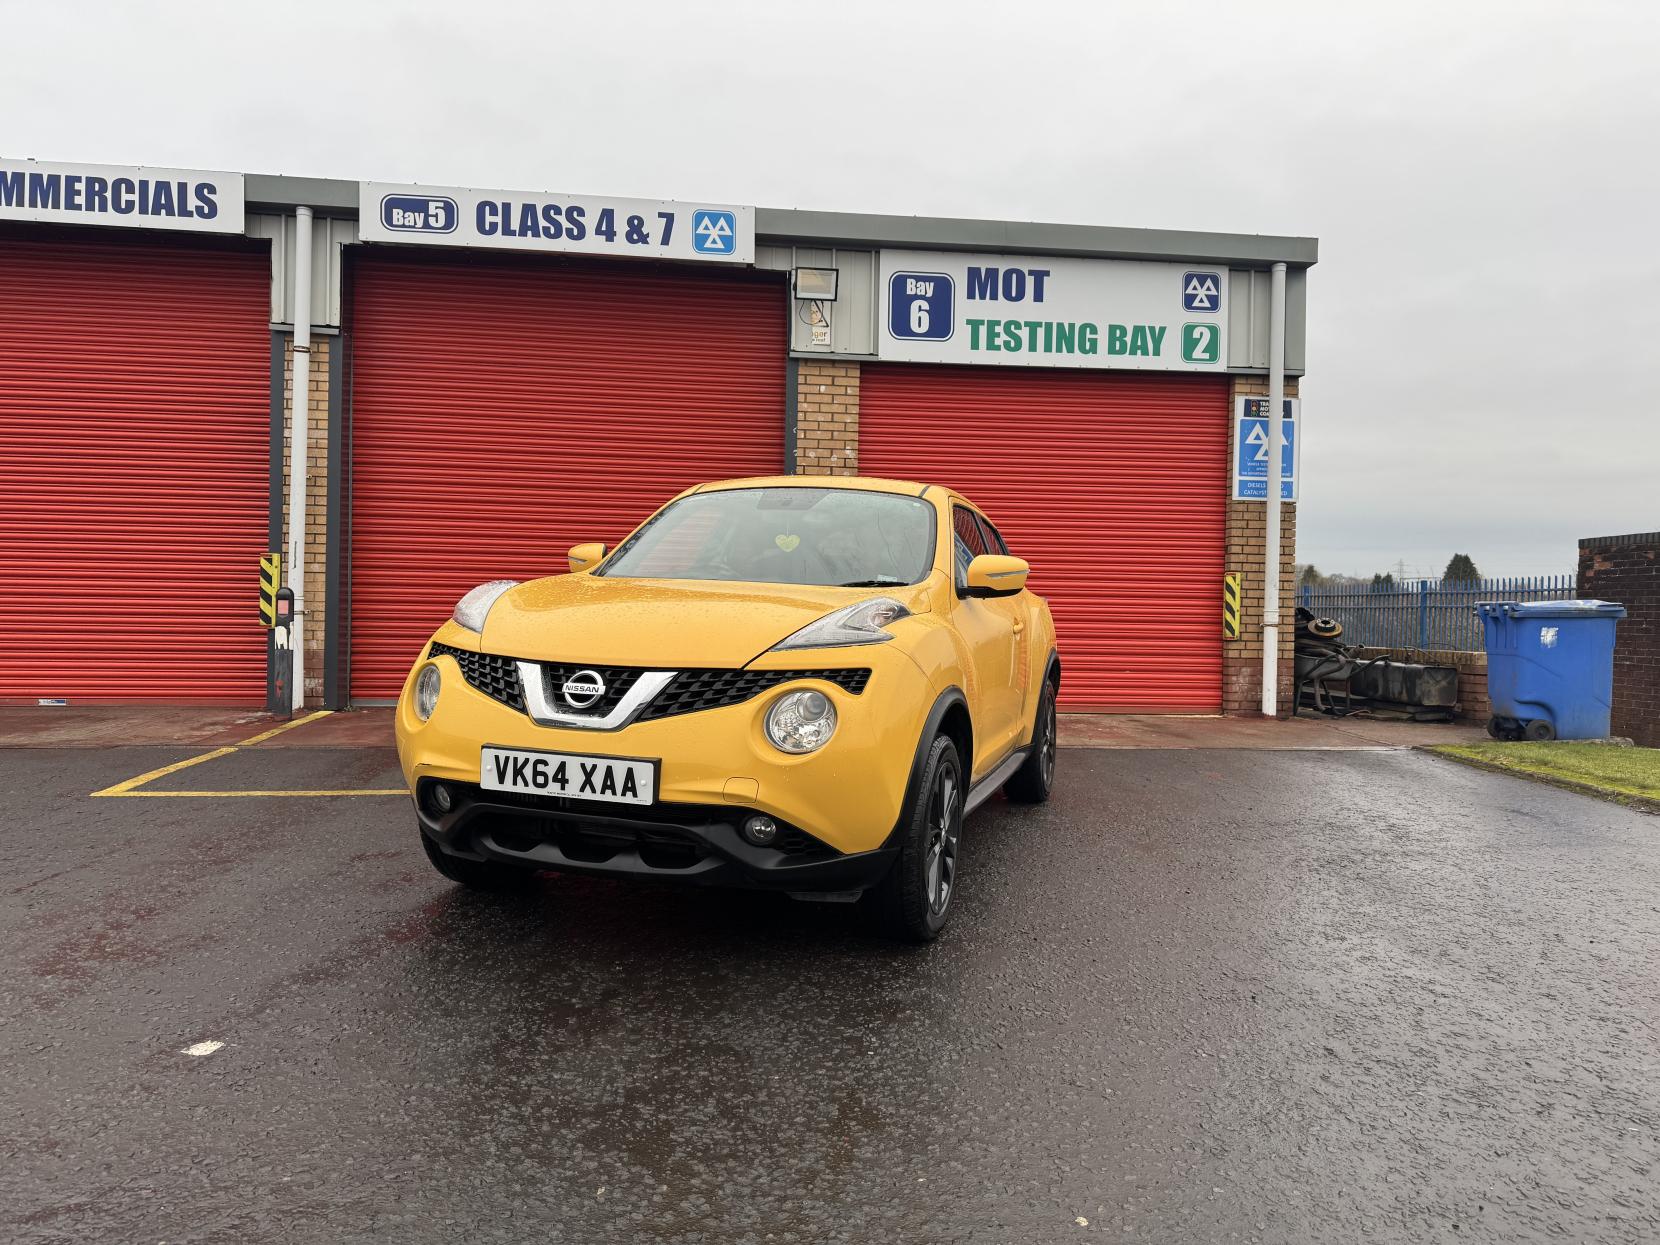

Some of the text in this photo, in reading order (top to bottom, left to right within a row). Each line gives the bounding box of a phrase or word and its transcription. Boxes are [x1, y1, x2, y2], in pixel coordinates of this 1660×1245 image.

[0, 170, 218, 220] MMERCIALS
[392, 201, 446, 228] Bay 5
[475, 200, 675, 247] CLASS 4 & 7
[906, 278, 935, 298] Bay
[966, 266, 1051, 303] MOT
[909, 299, 930, 334] 6
[965, 318, 1168, 357] TESTING BAY
[1191, 326, 1211, 360] 2
[564, 684, 600, 693] NISSAN
[494, 754, 638, 799] VK64 XAA
